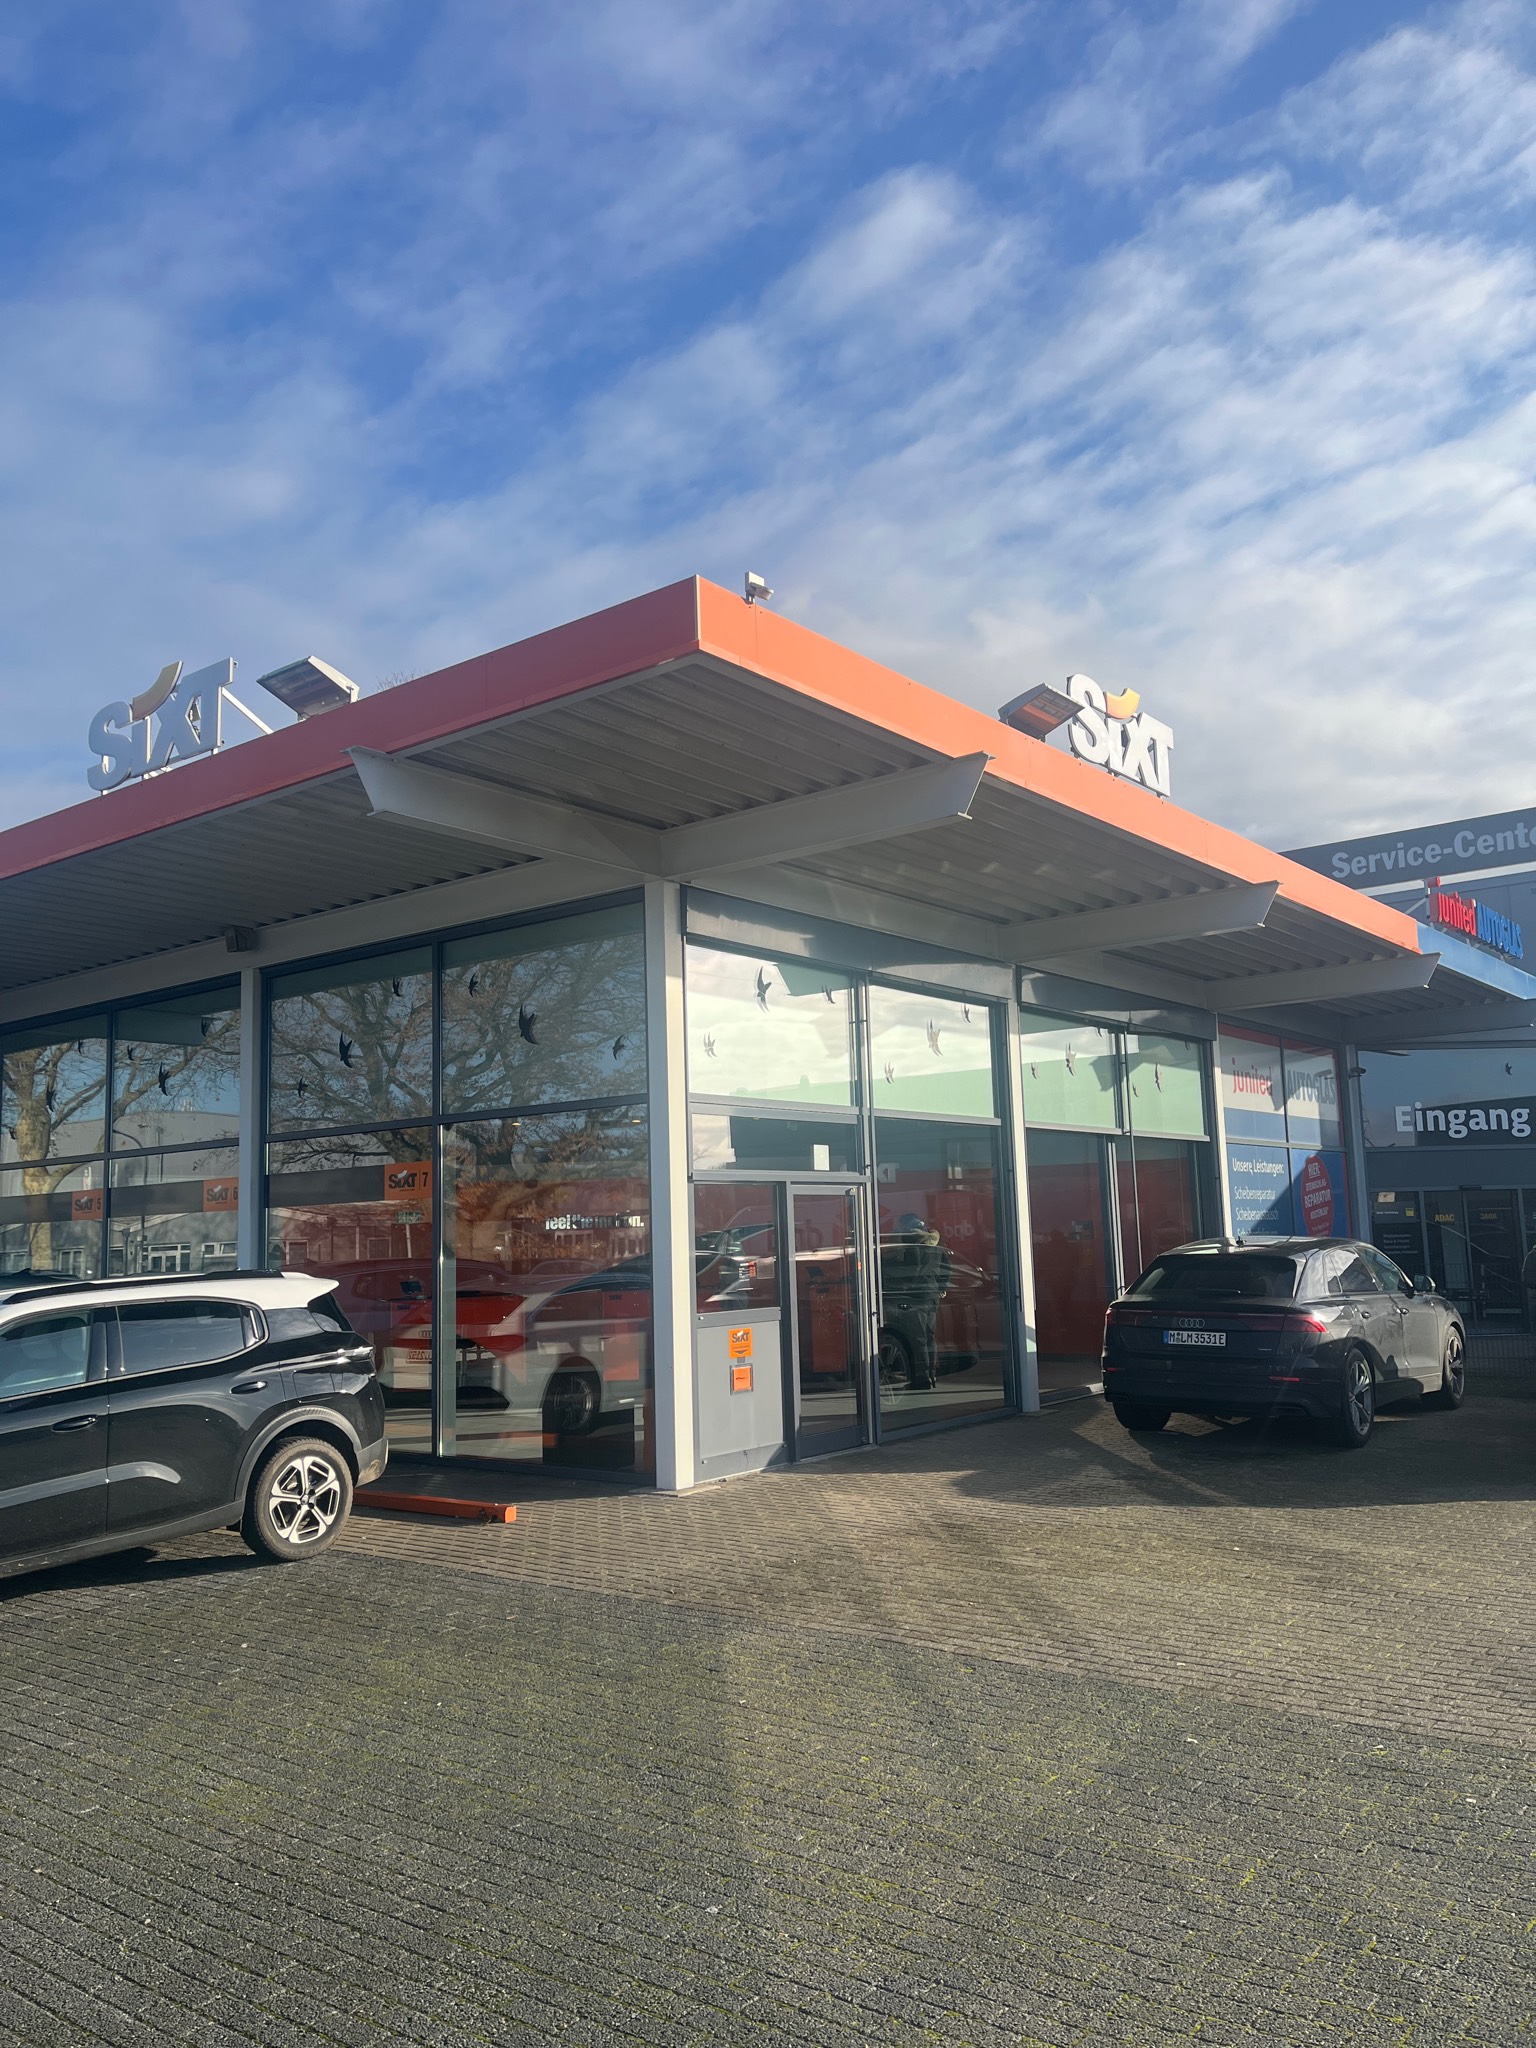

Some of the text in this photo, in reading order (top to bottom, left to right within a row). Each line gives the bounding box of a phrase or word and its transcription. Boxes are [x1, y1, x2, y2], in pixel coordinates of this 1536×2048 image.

[1066, 673, 1174, 797] SIXT
[1232, 1057, 1273, 1097] junited
[1394, 1101, 1531, 1138] Eingang
[389, 1170, 428, 1189] SIXT 7
[233, 1190, 238, 1200] 6
[97, 1197, 101, 1210] 5
[1434, 1214, 1456, 1222] ADAC
[732, 1330, 749, 1343] SIXT
